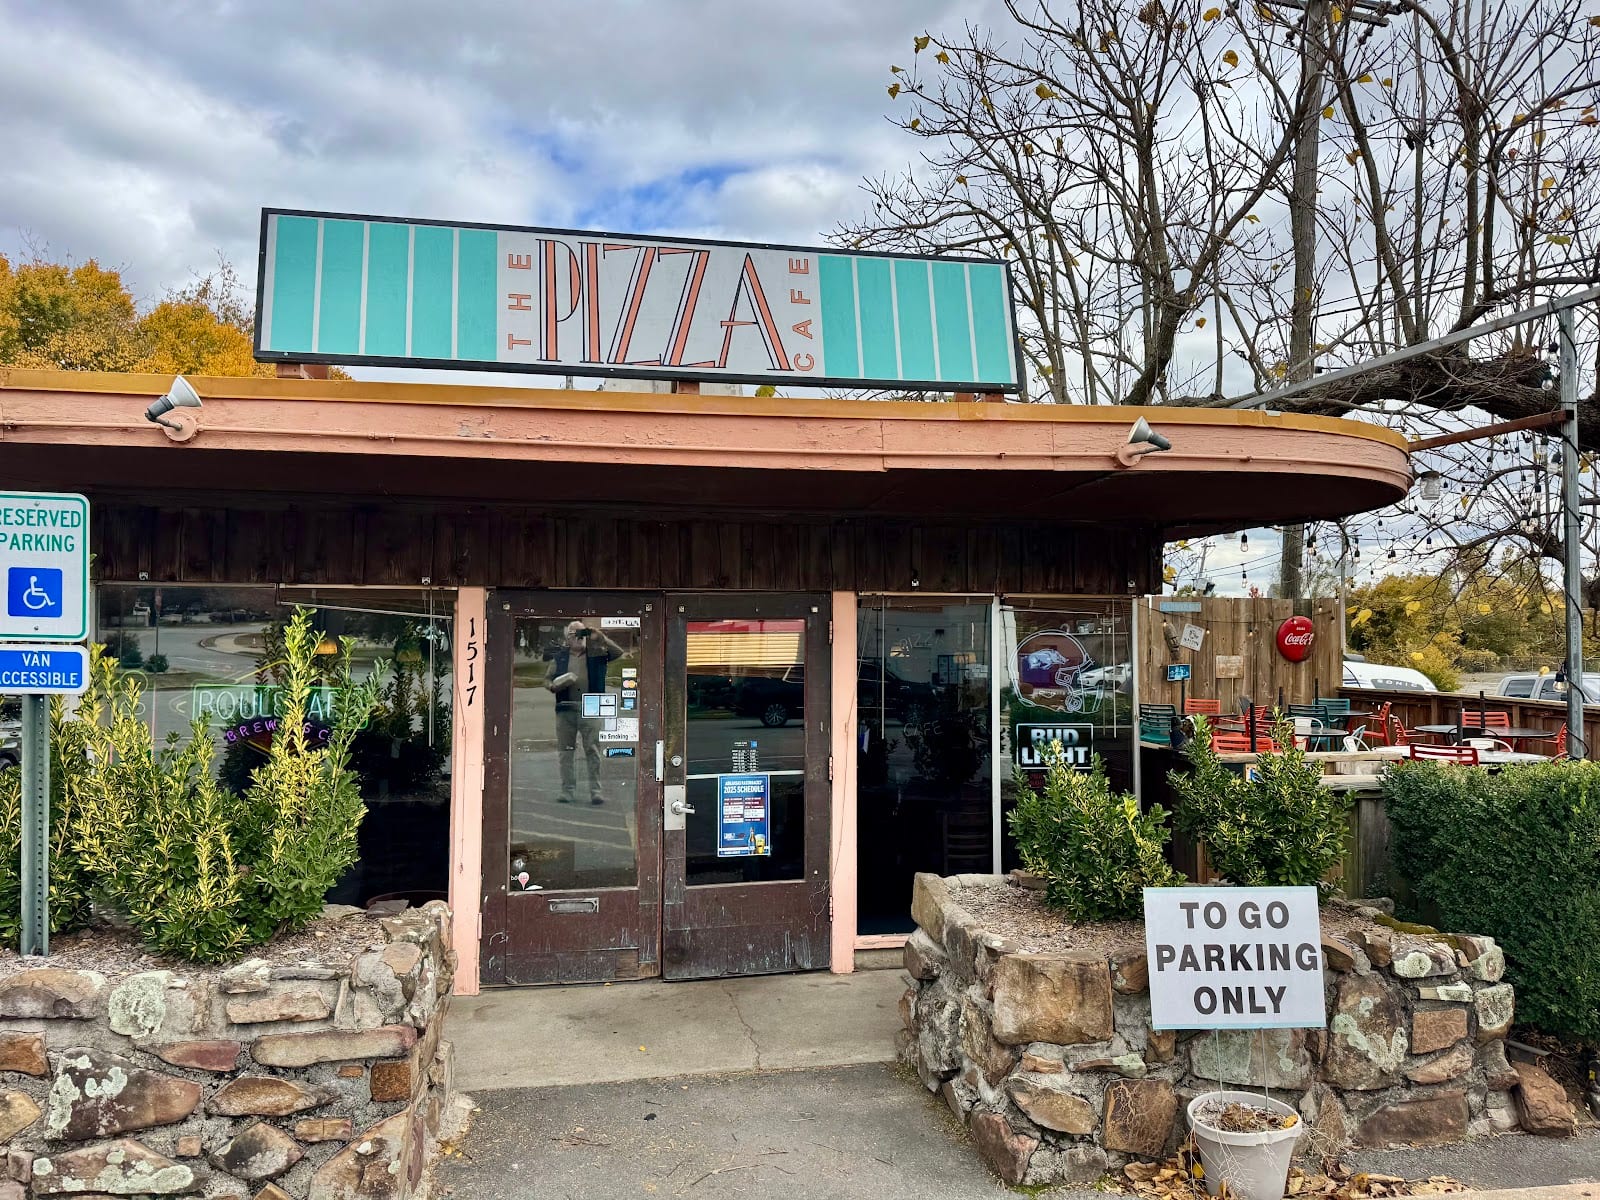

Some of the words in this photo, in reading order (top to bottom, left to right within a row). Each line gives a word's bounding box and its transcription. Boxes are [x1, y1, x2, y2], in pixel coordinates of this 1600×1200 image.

[508, 253, 532, 350] THE
[536, 238, 794, 371] PIZZA
[789, 257, 815, 371] CAFE
[0, 508, 81, 528] ESERVED
[1284, 632, 1315, 646] Coca-Col
[22, 653, 50, 667] VAN
[466, 617, 478, 706] 1517
[0, 671, 78, 687] CCESSIBLE
[608, 733, 629, 741] Smoking
[1031, 729, 1079, 746] BUD
[1022, 747, 1089, 765] LIHT
[737, 785, 764, 793] SCHEDULE
[1180, 902, 1227, 929] TO
[1238, 901, 1290, 929] GO
[1156, 943, 1318, 972] PARKING
[1193, 986, 1287, 1015] ONLY
